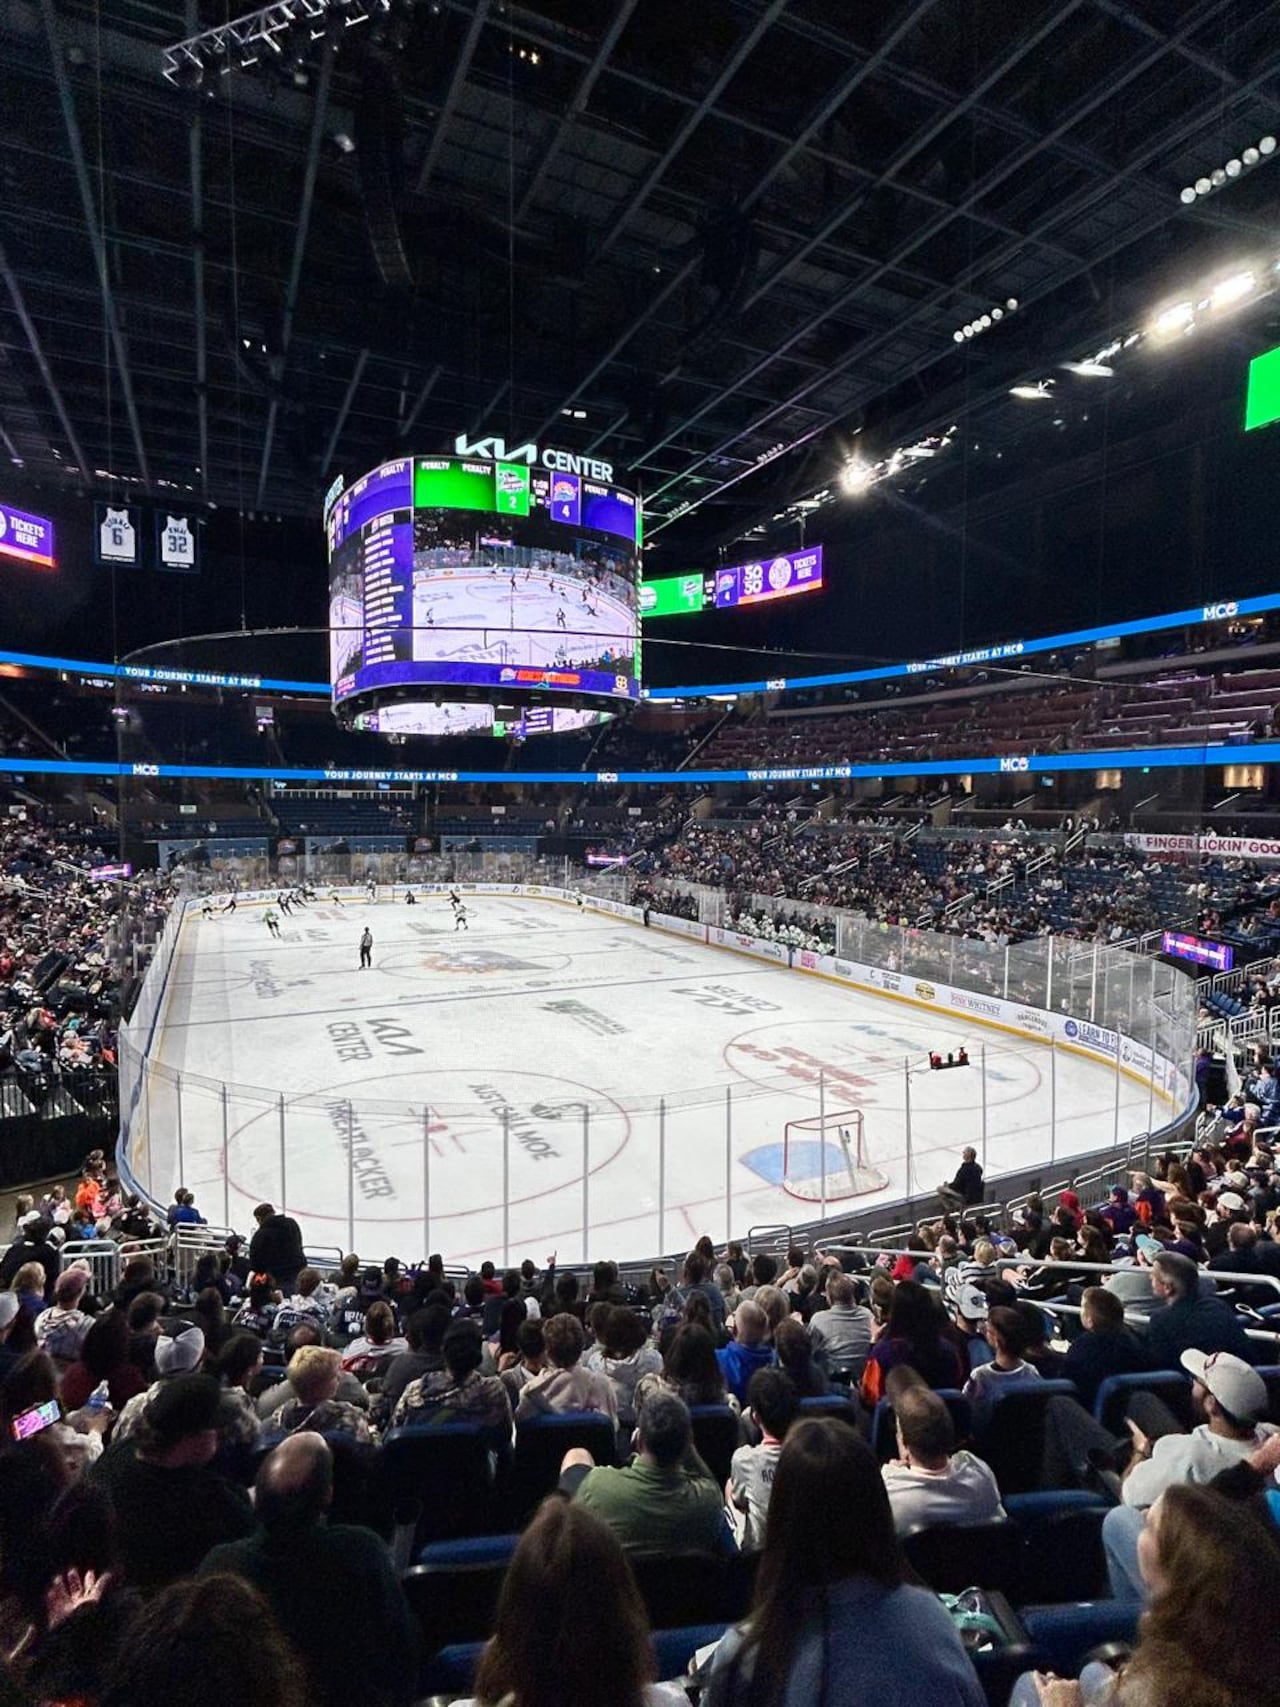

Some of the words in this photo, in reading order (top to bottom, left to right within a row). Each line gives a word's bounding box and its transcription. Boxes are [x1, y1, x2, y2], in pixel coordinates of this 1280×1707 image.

[421, 461, 450, 470] PENALTY
[462, 463, 492, 475] PENALTY
[542, 449, 613, 483] CENTER
[562, 504, 570, 518] 4
[10, 516, 44, 538] TICKETS
[16, 531, 38, 547] HERE
[112, 528, 122, 546] 6
[168, 535, 187, 554] 32
[744, 564, 764, 581] 50
[744, 580, 764, 596] 50
[963, 649, 990, 663] STARTS
[991, 646, 1003, 657] AT
[125, 666, 150, 677] YOUR
[153, 668, 195, 682] JOURNEY
[196, 672, 226, 684] STARTS
[229, 675, 240, 685] AT
[324, 770, 349, 779] YOUR
[351, 770, 393, 780] JOURNEY
[394, 771, 423, 780] STARTS
[426, 772, 437, 780] AT
[747, 770, 768, 780] YOUR
[769, 769, 800, 779] JOURNEY
[801, 767, 824, 778] STARTS
[825, 767, 834, 777] AT
[1146, 836, 1193, 850] FINGER
[1078, 1022, 1100, 1039] LEARN
[326, 1021, 374, 1062] CENTER
[467, 1084, 507, 1105] JUST
[513, 1130, 562, 1161] MOE
